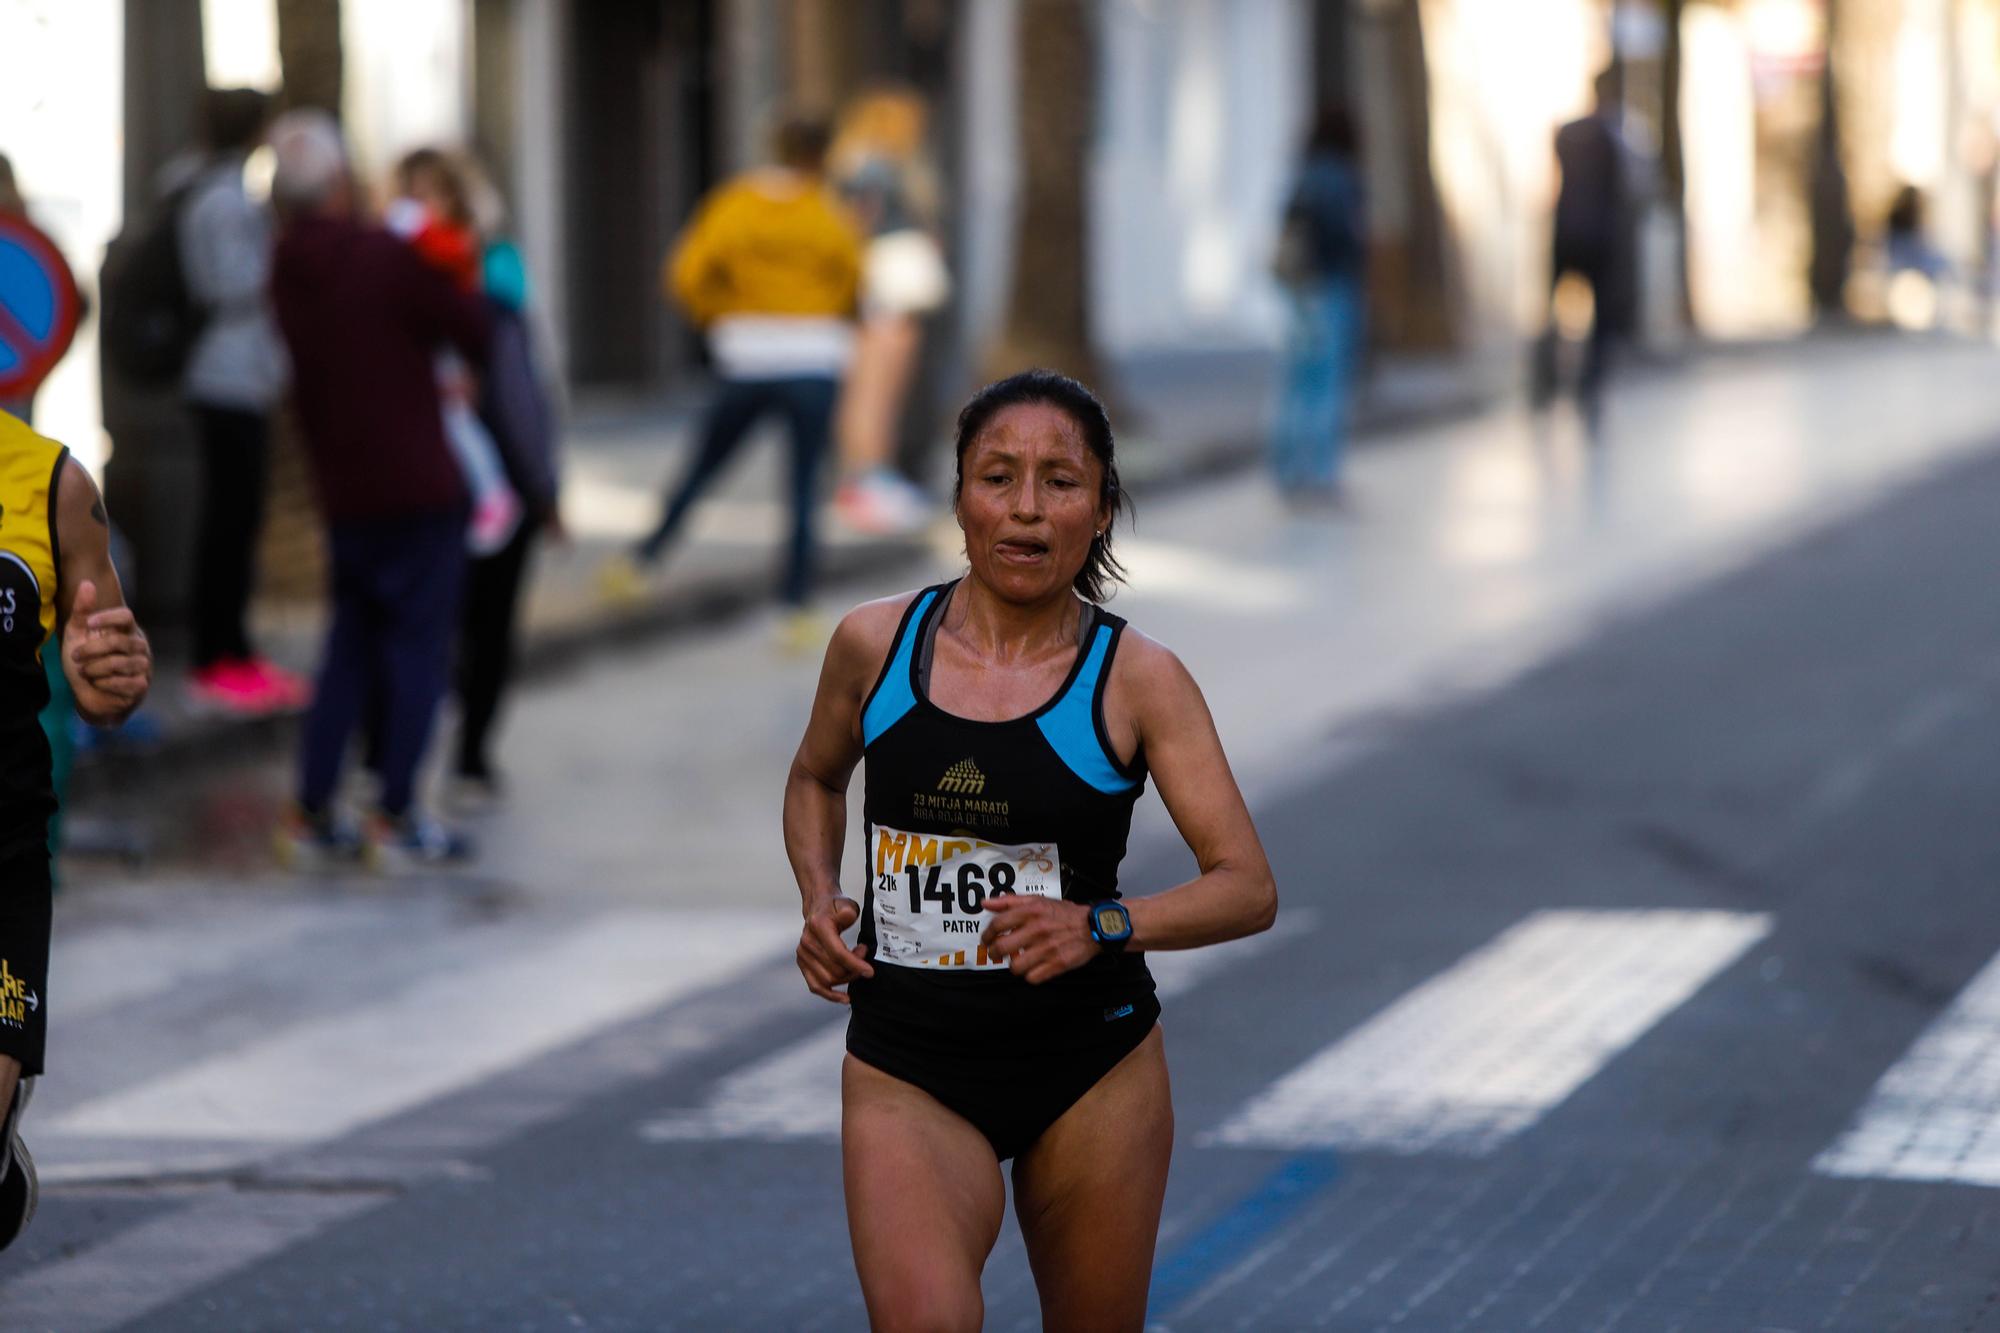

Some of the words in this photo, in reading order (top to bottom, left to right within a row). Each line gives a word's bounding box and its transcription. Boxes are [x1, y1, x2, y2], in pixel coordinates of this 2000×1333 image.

[913, 792, 926, 806] 23
[928, 794, 961, 811] MITJA
[905, 862, 1017, 915] 1468
[943, 920, 980, 933] PATRY
